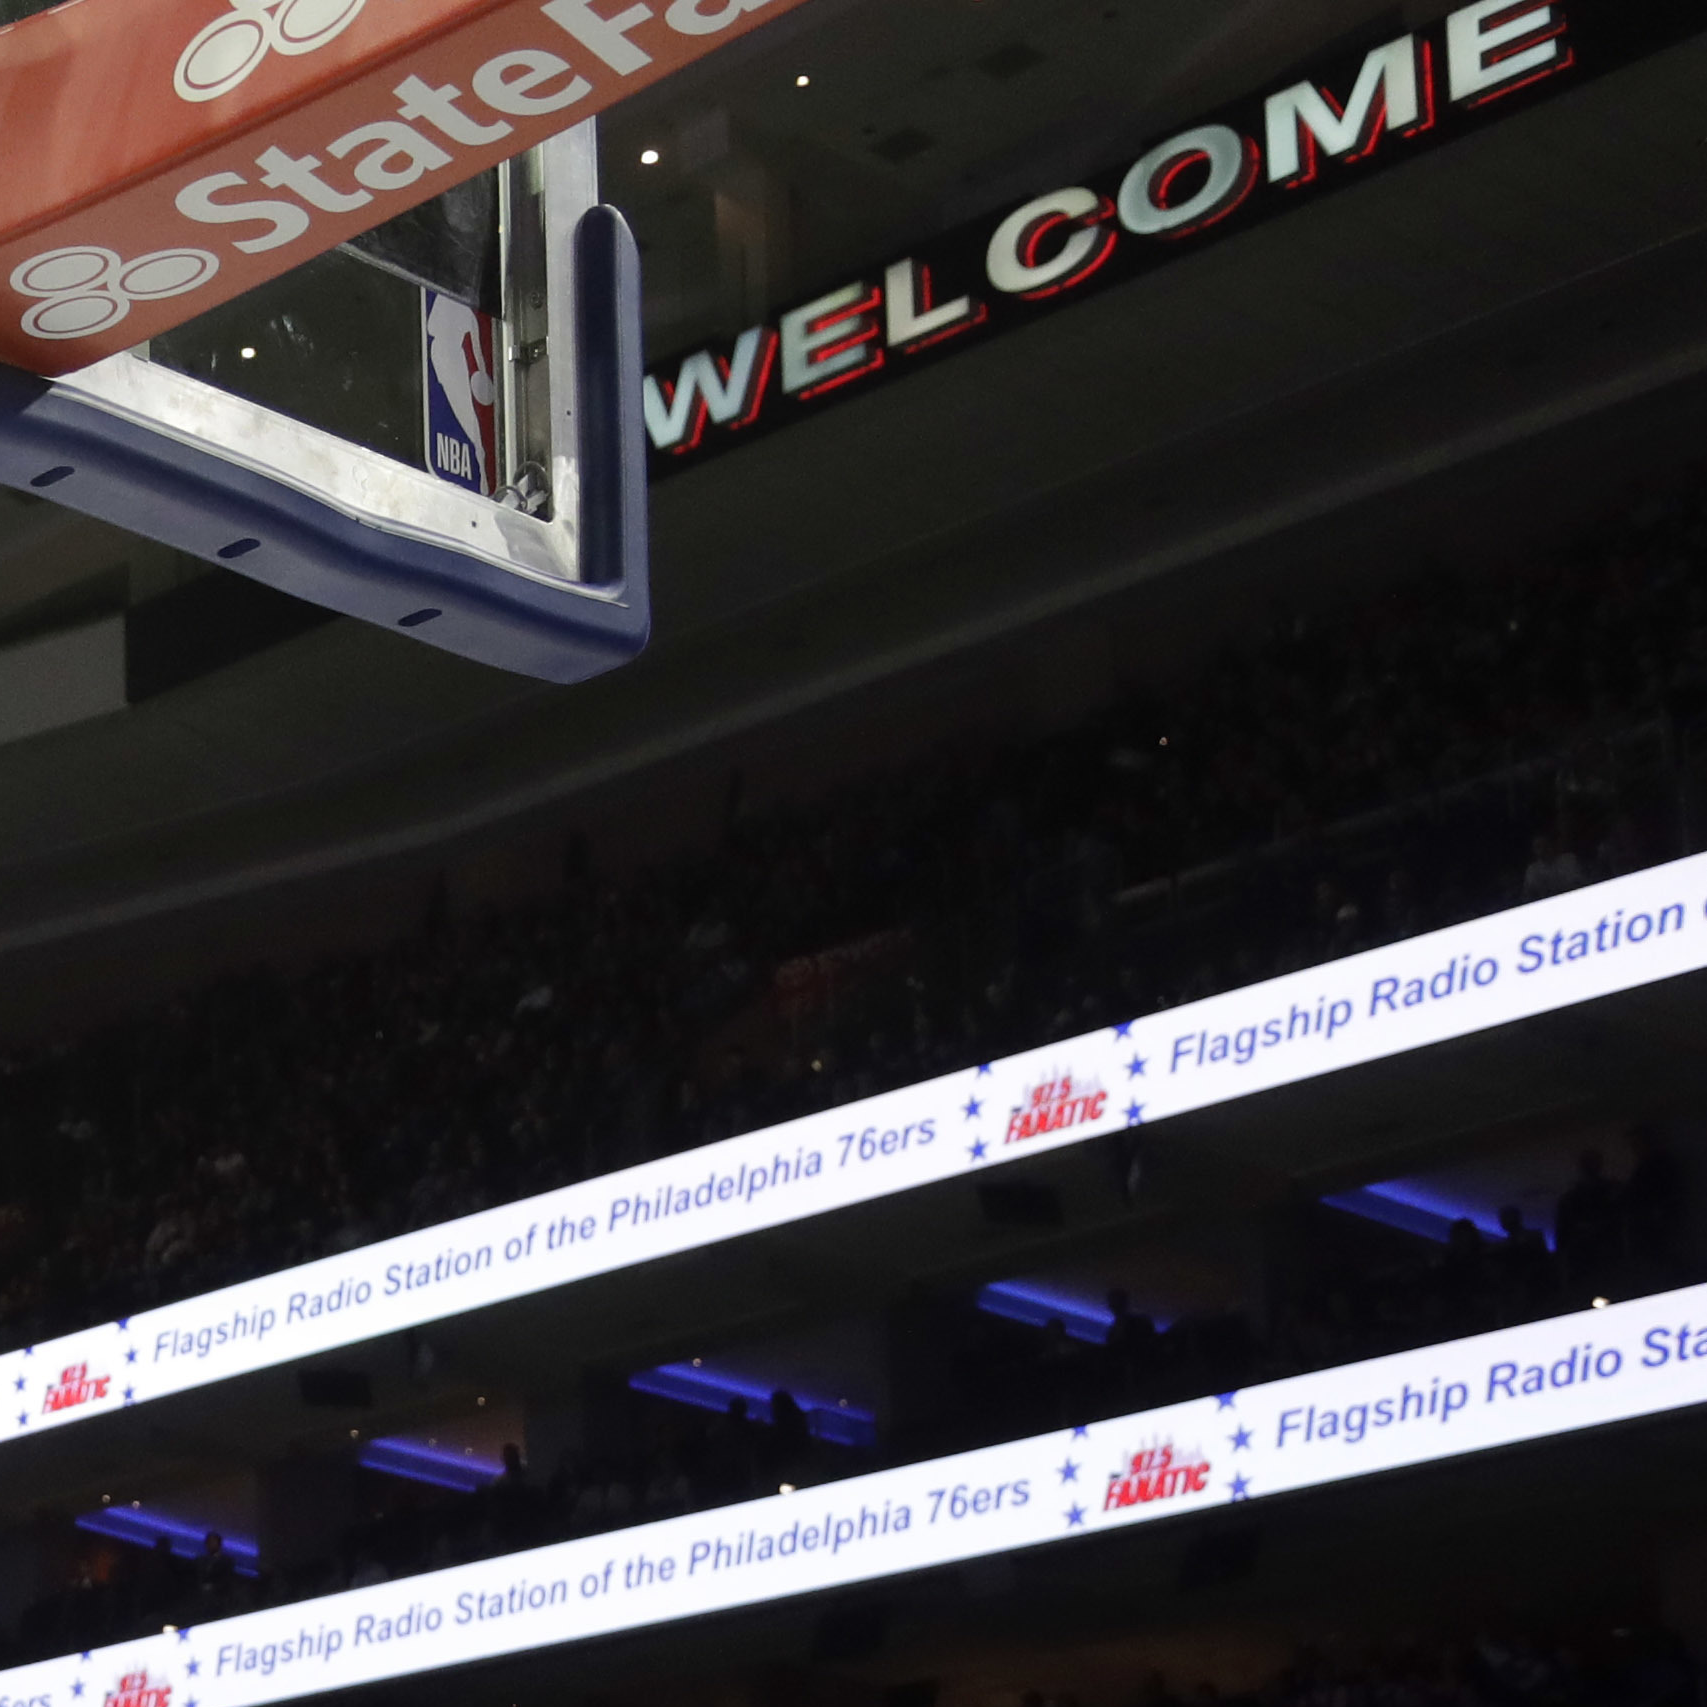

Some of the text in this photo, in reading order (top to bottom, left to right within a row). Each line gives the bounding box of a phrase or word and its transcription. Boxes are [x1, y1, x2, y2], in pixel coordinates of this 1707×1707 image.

[643, 0, 1574, 452] WELCOME
[436, 432, 472, 480] NBA
[1171, 997, 1354, 1073] Flagship
[1369, 954, 1500, 1017] Radio
[1517, 902, 1686, 974] Station
[1004, 1090, 1107, 1144] FANATIC
[154, 1118, 937, 1362] Flagship Radio Station of the Philadelphia 76ers
[1277, 1343, 1624, 1448] Flagship Radio
[1103, 1461, 1211, 1512] FANATIC
[216, 1479, 1031, 1677] Flagship Radio Station of the Philadelphia 76ers
